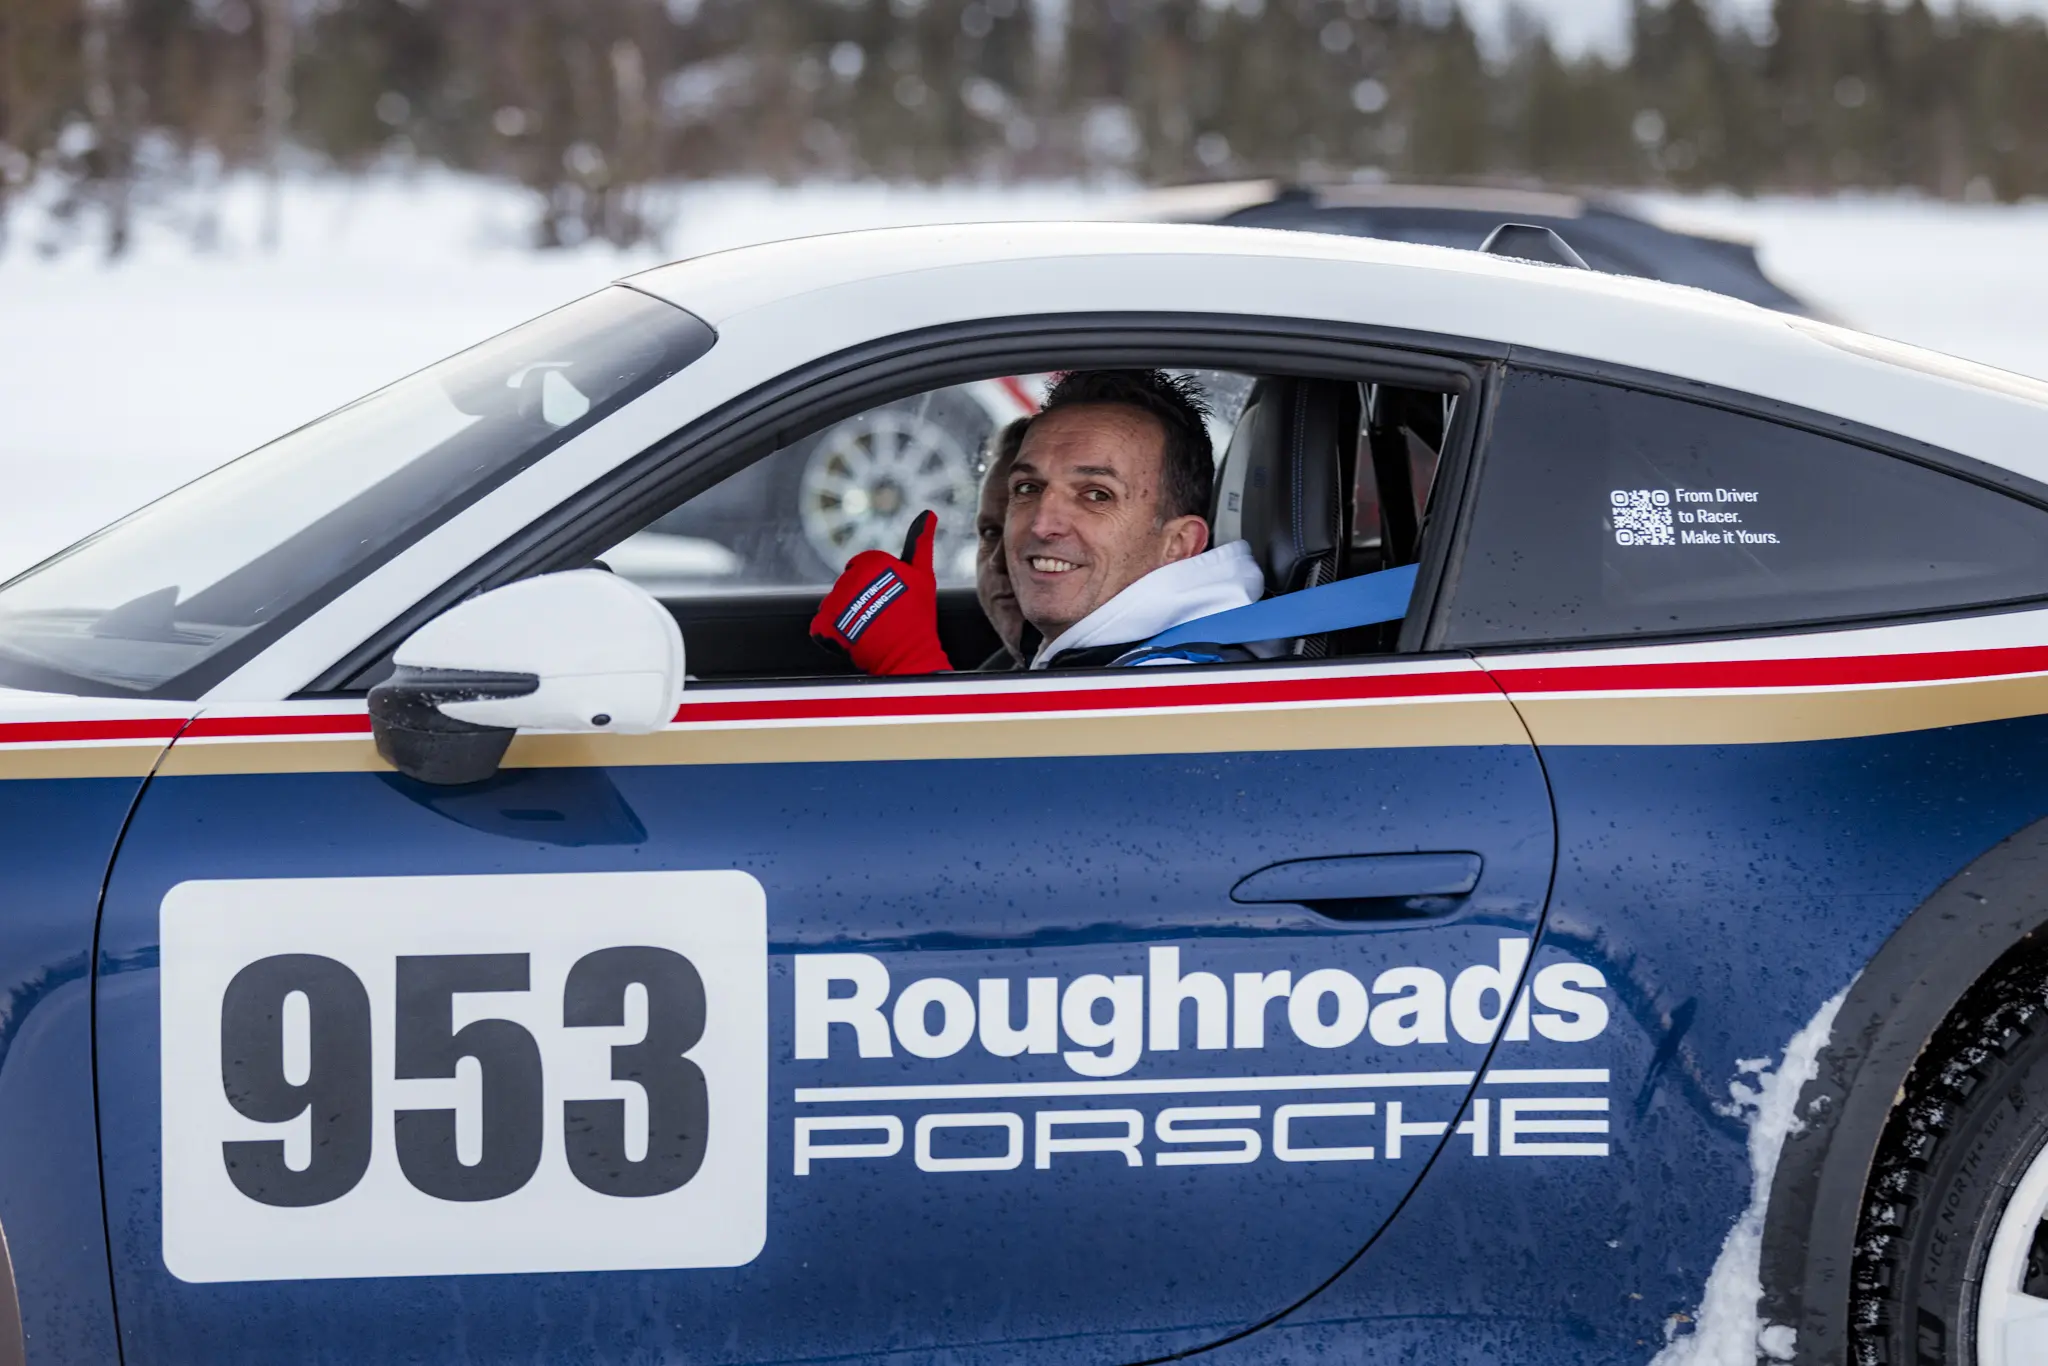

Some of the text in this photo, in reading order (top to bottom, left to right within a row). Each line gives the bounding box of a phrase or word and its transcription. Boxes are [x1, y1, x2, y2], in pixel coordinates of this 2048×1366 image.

[1675, 488, 1759, 502] From Driver
[1678, 509, 1742, 523] to Racer.
[1681, 530, 1780, 544] Make it Yours.
[850, 584, 880, 613] MARTINI
[860, 594, 889, 622] RACING
[794, 937, 1610, 1078] Roughroads
[221, 945, 710, 1208] 953
[794, 1097, 1610, 1176] PORSCHE
[1924, 1229, 1949, 1291] X-ICE
